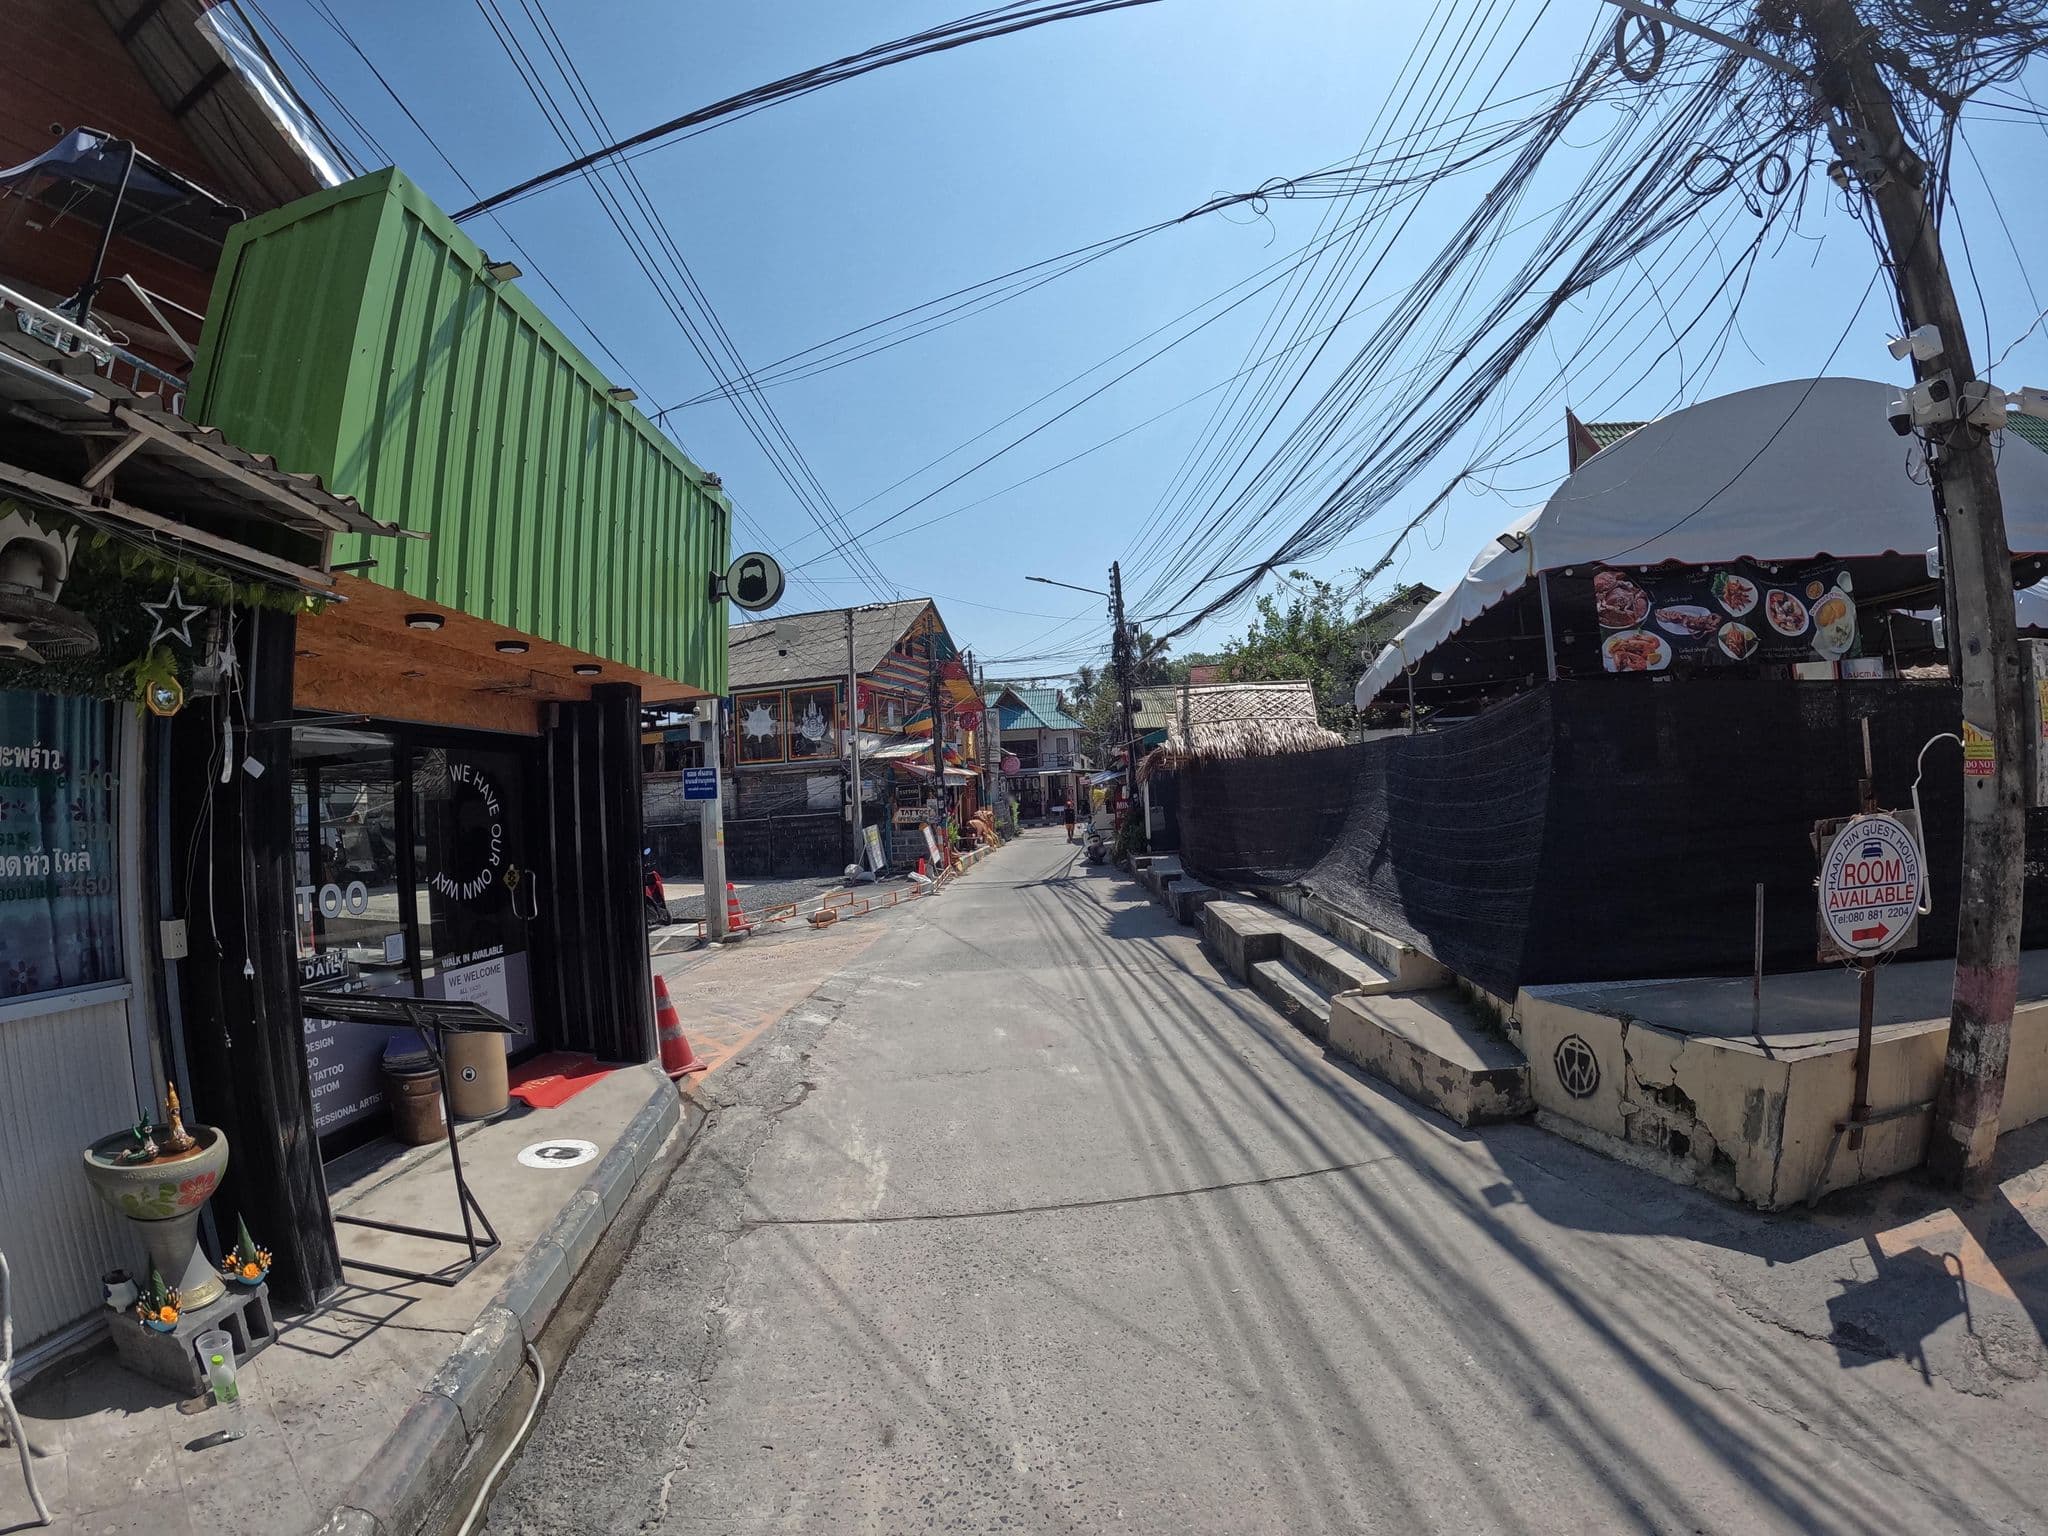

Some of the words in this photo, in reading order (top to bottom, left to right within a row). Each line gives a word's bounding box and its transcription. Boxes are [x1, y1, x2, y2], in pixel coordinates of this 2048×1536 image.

[0, 739, 61, 770] ะพร้าว
[450, 764, 471, 783] WE
[473, 772, 500, 816] HAVE
[489, 824, 502, 866] OUR
[1828, 852, 1844, 890] HAAD
[1843, 831, 1860, 851] RIN
[1863, 824, 1897, 840] GUEST
[1896, 837, 1916, 881] HOUSE
[432, 872, 459, 900] WAY
[463, 869, 492, 900] OWN
[1844, 859, 1901, 887] ROOM
[1829, 884, 1914, 910] AVAILABLE
[1832, 912, 1865, 925] Tel:080
[1867, 911, 1883, 919] 881
[1888, 907, 1909, 918] 2204
[442, 956, 462, 968] WALK
[463, 953, 470, 963] IN
[472, 944, 504, 960] AVAILABLE
[305, 960, 346, 980] DAILY
[449, 974, 462, 988] WE
[464, 964, 501, 983] WELCOME
[314, 1063, 345, 1081] TATTOO
[359, 1092, 384, 1109] ARTIST
